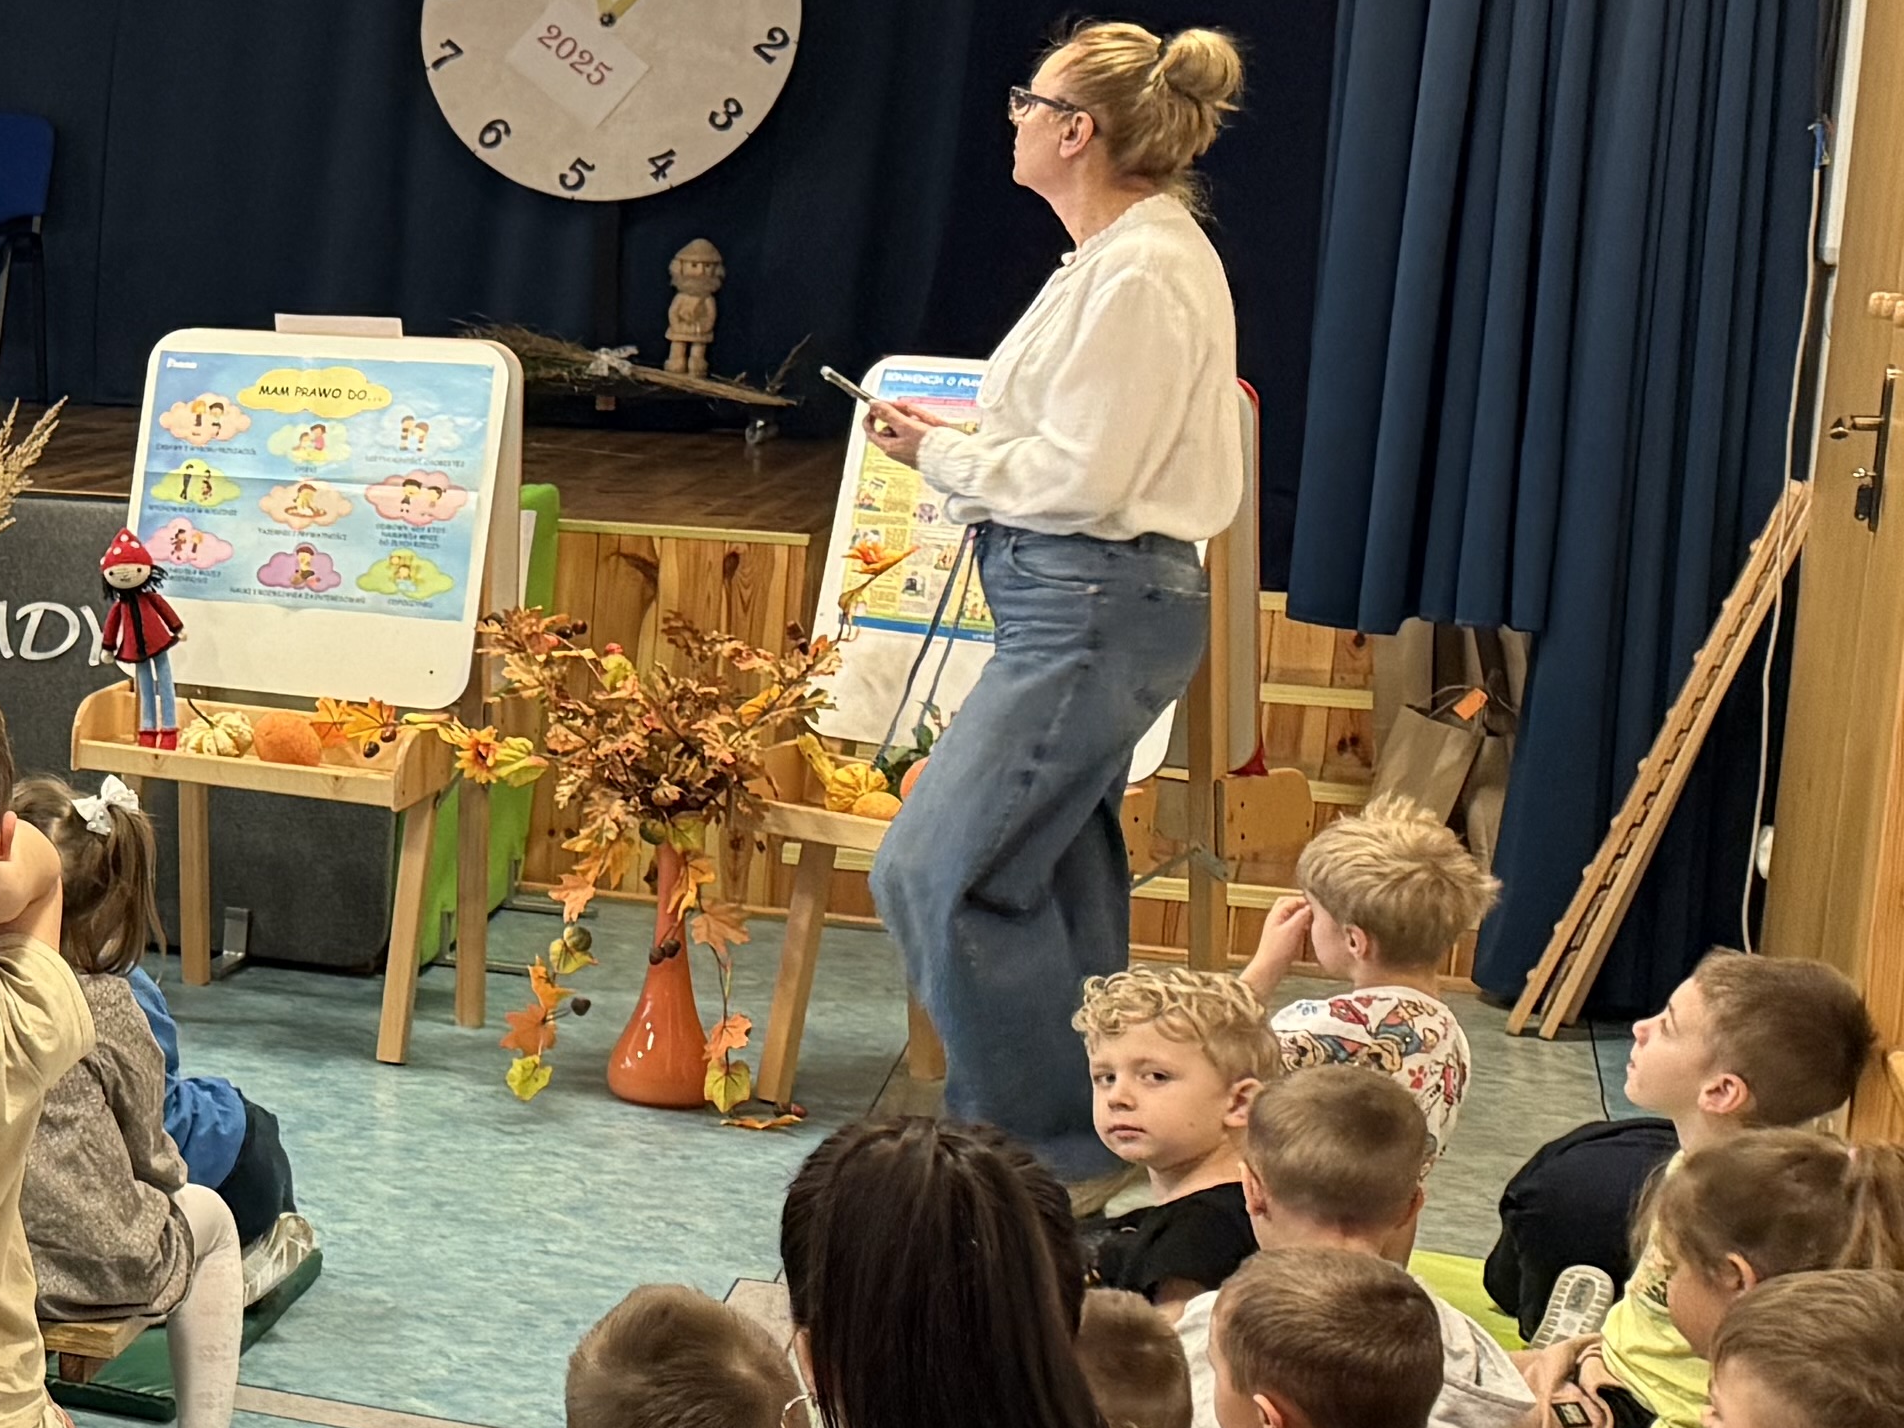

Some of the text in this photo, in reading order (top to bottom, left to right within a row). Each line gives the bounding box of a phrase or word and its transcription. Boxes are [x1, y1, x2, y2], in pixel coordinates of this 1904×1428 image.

[432, 39, 465, 73] 7
[537, 24, 612, 87] 2025
[752, 27, 789, 64] 2
[708, 98, 744, 131] 3
[478, 119, 511, 149] 6
[558, 157, 595, 191] 5
[648, 149, 676, 181] 4
[259, 385, 290, 397] MAM
[295, 386, 342, 400] PRAWO
